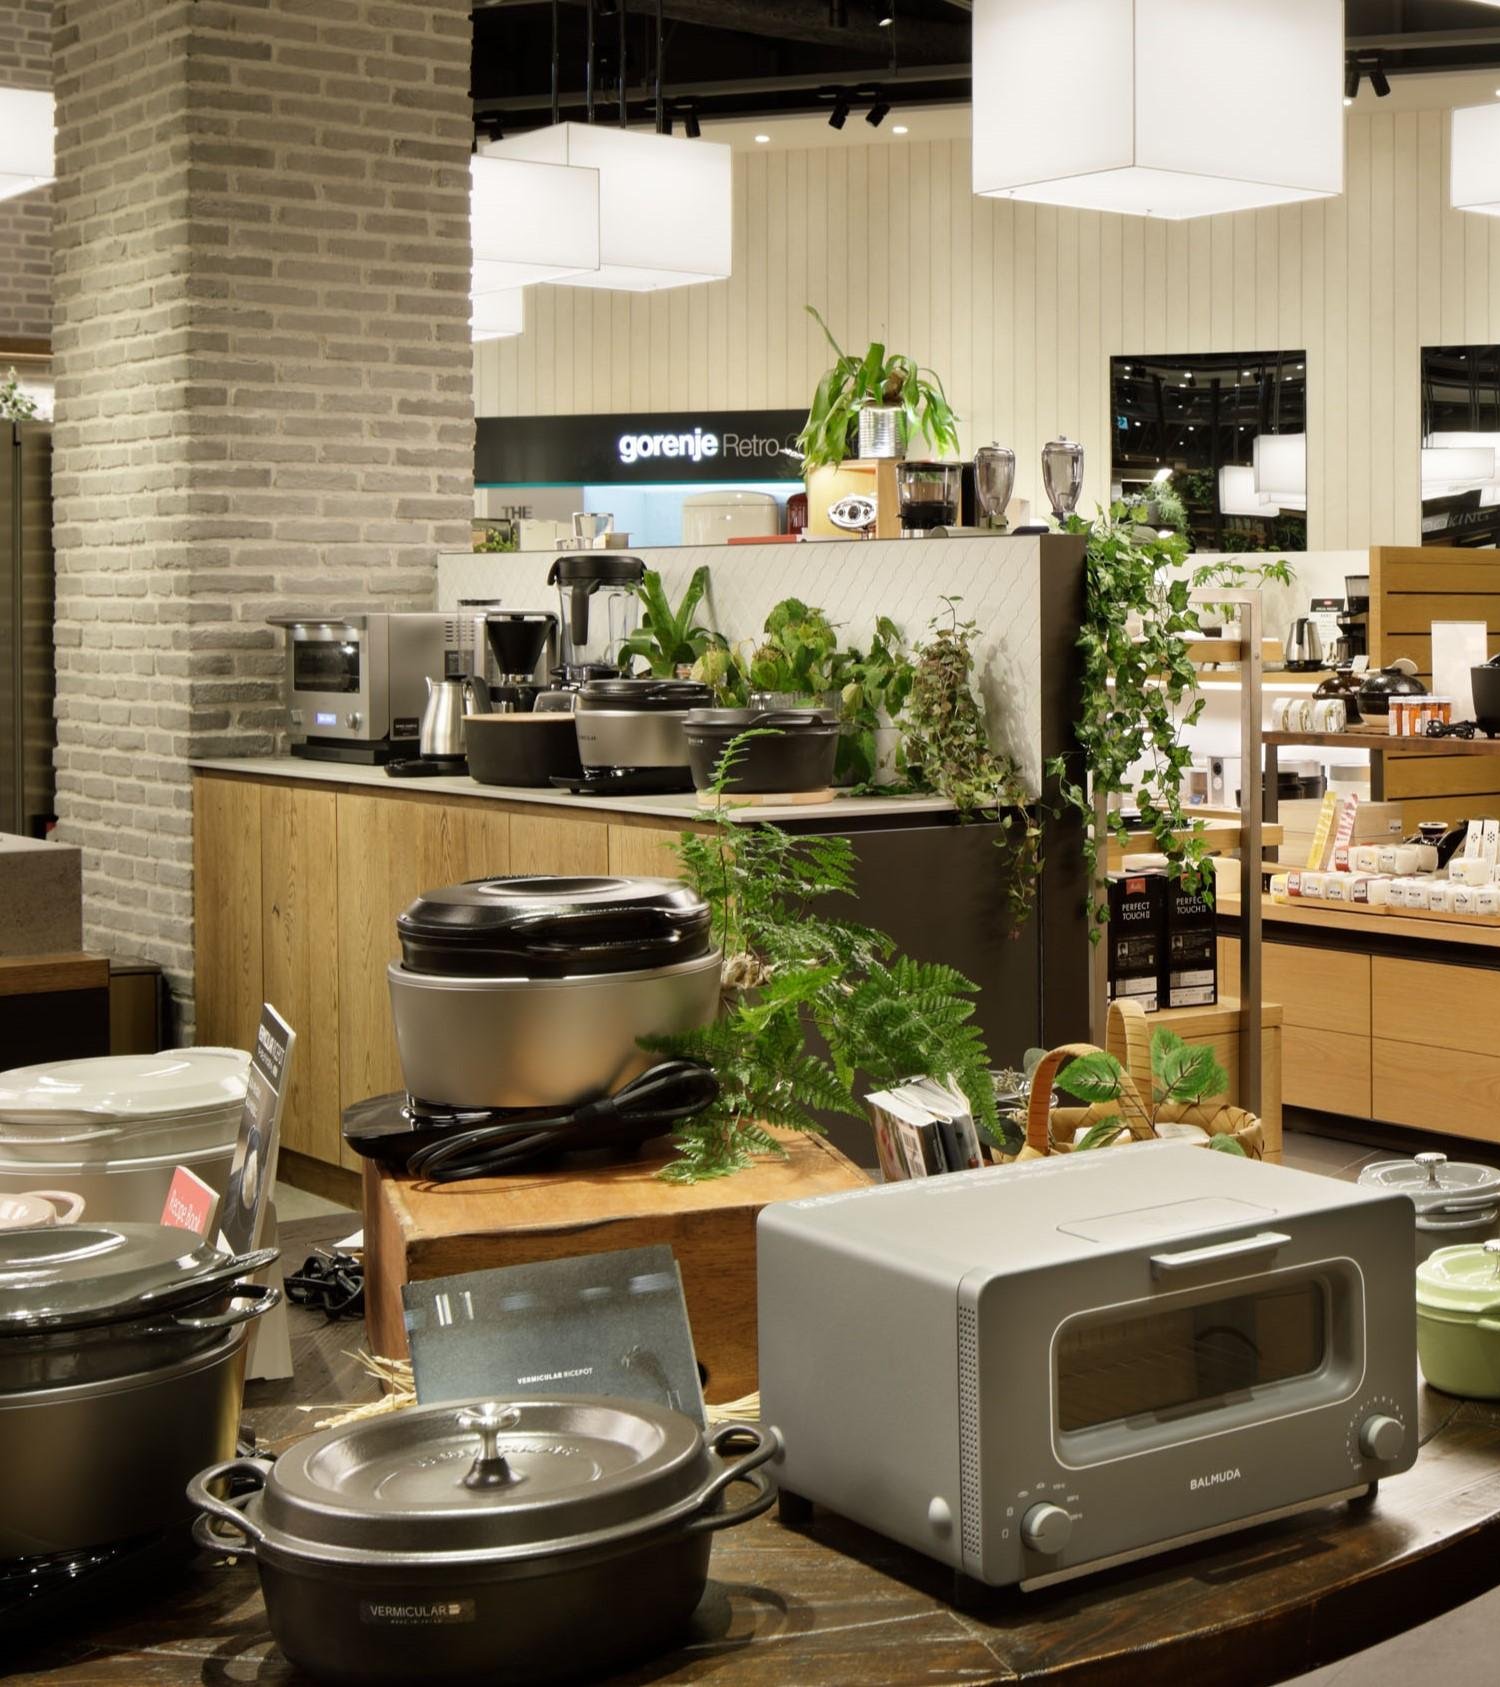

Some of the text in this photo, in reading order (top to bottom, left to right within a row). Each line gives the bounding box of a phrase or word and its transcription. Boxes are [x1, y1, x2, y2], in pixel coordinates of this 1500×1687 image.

[619, 428, 718, 463] gorenje
[723, 433, 780, 457] Retro
[1122, 902, 1150, 911] PERFECT
[1176, 896, 1203, 906] PERFEC
[1176, 904, 1200, 914] TOUCH
[1122, 911, 1145, 920] TOUCH
[517, 1367, 593, 1385] VERMICULAR RICEPOT
[1189, 1468, 1241, 1491] BALMUDA
[370, 1604, 448, 1618] VERMICULAR
